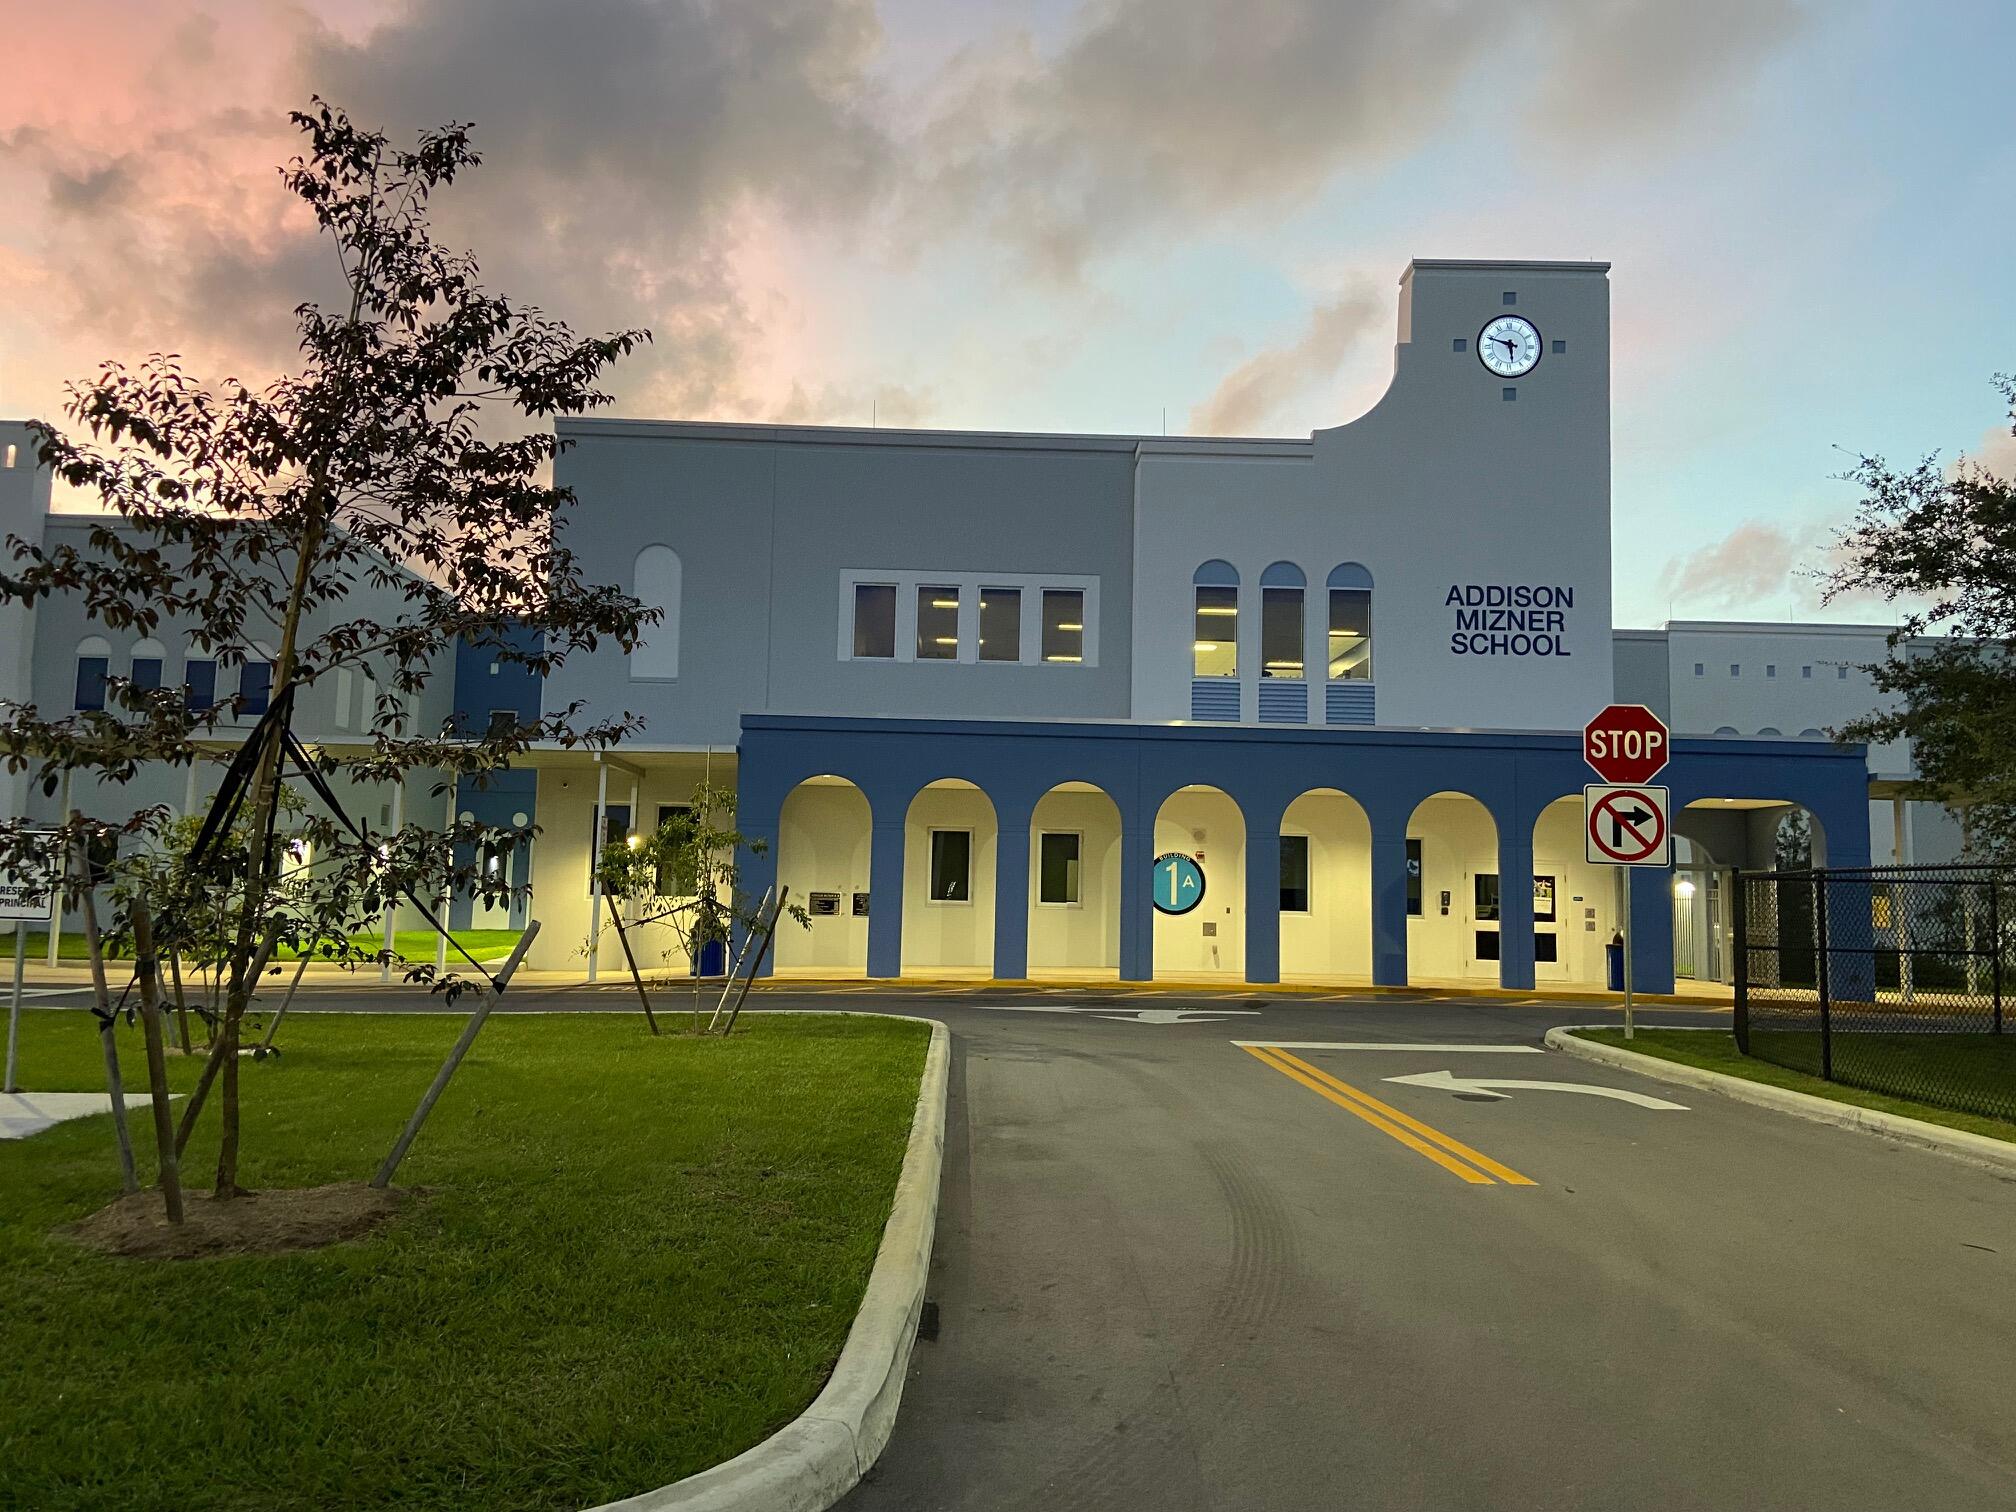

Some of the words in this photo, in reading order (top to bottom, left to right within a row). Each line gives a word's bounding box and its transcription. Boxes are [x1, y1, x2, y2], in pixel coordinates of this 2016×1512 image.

[1445, 585, 1573, 608] ADDISON
[1456, 609, 1565, 632] MIZNER
[1451, 633, 1571, 656] SCHOOL
[1590, 729, 1663, 760] STOP
